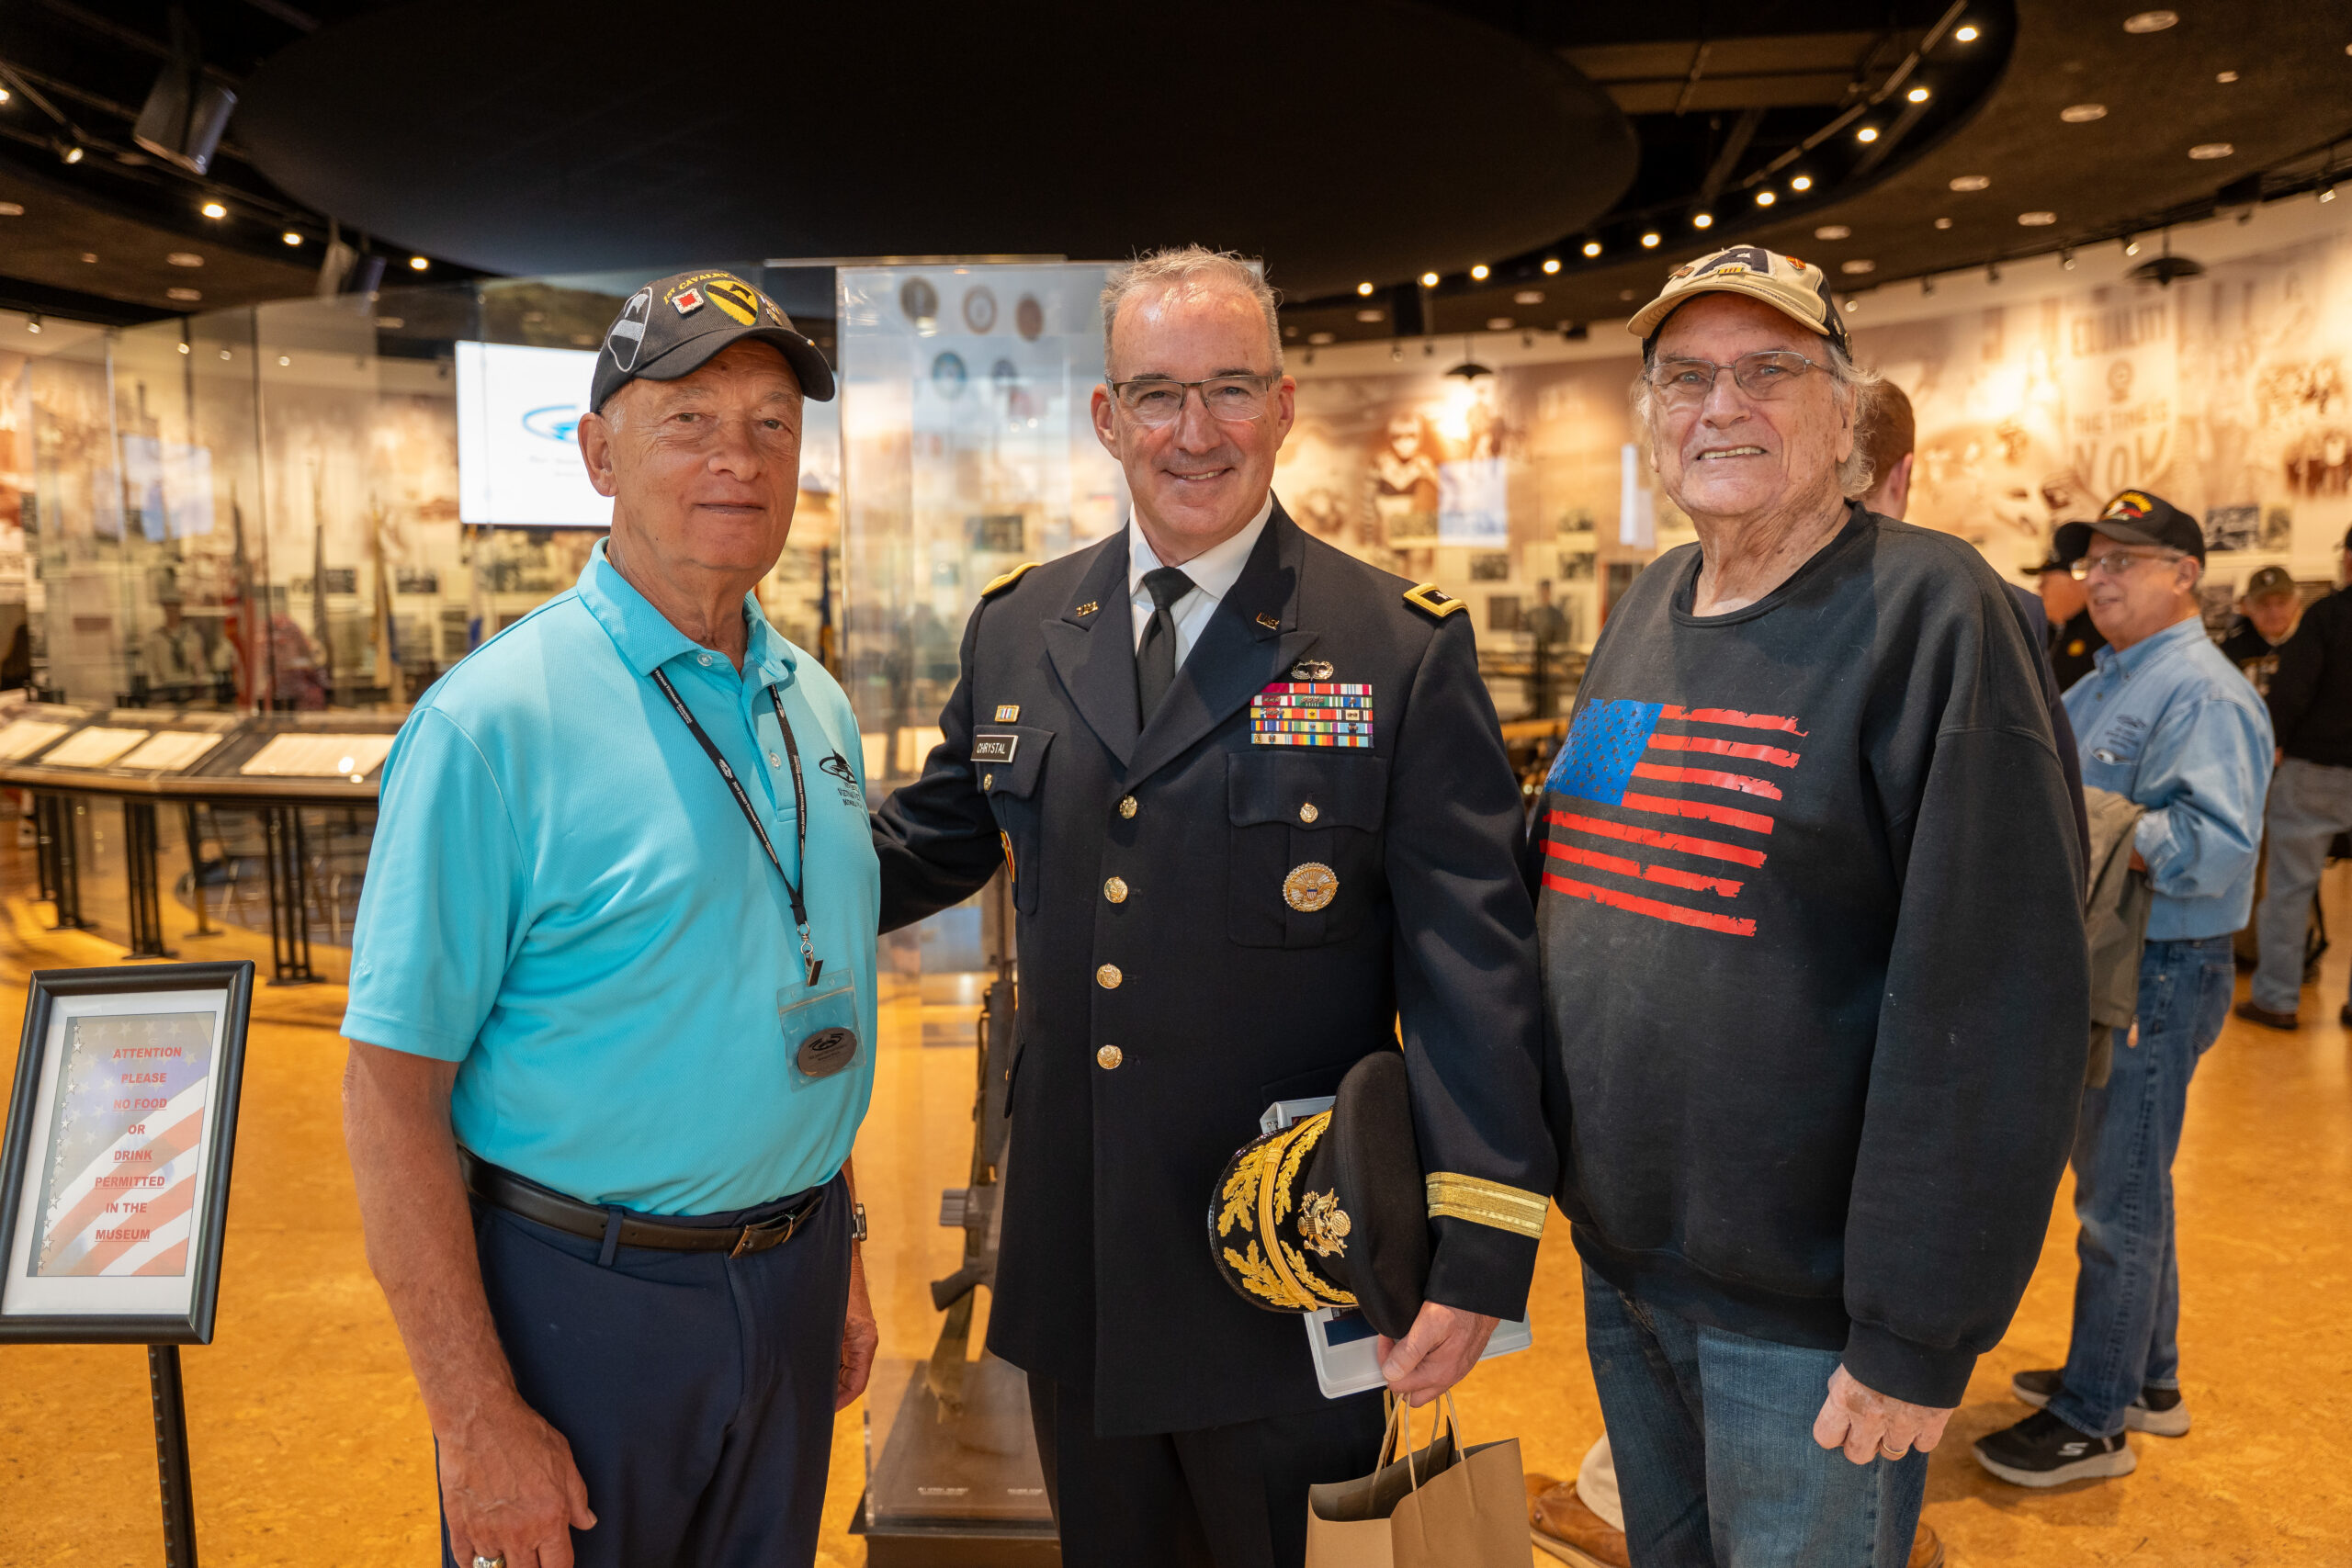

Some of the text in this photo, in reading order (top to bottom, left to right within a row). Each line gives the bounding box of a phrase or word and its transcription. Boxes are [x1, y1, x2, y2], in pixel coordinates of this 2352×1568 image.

[679, 273, 729, 290] CAVALRY
[977, 742, 1005, 754] CHRYSTAL
[113, 1047, 182, 1059] ATTENTION
[121, 1073, 167, 1084] PLEASE
[113, 1098, 167, 1110] NO FOOD
[128, 1124, 145, 1134] OR
[114, 1150, 153, 1161] DRINK
[95, 1177, 165, 1188] PERMITTED
[106, 1202, 148, 1213] IN THE
[96, 1229, 150, 1240] MUSEUM
